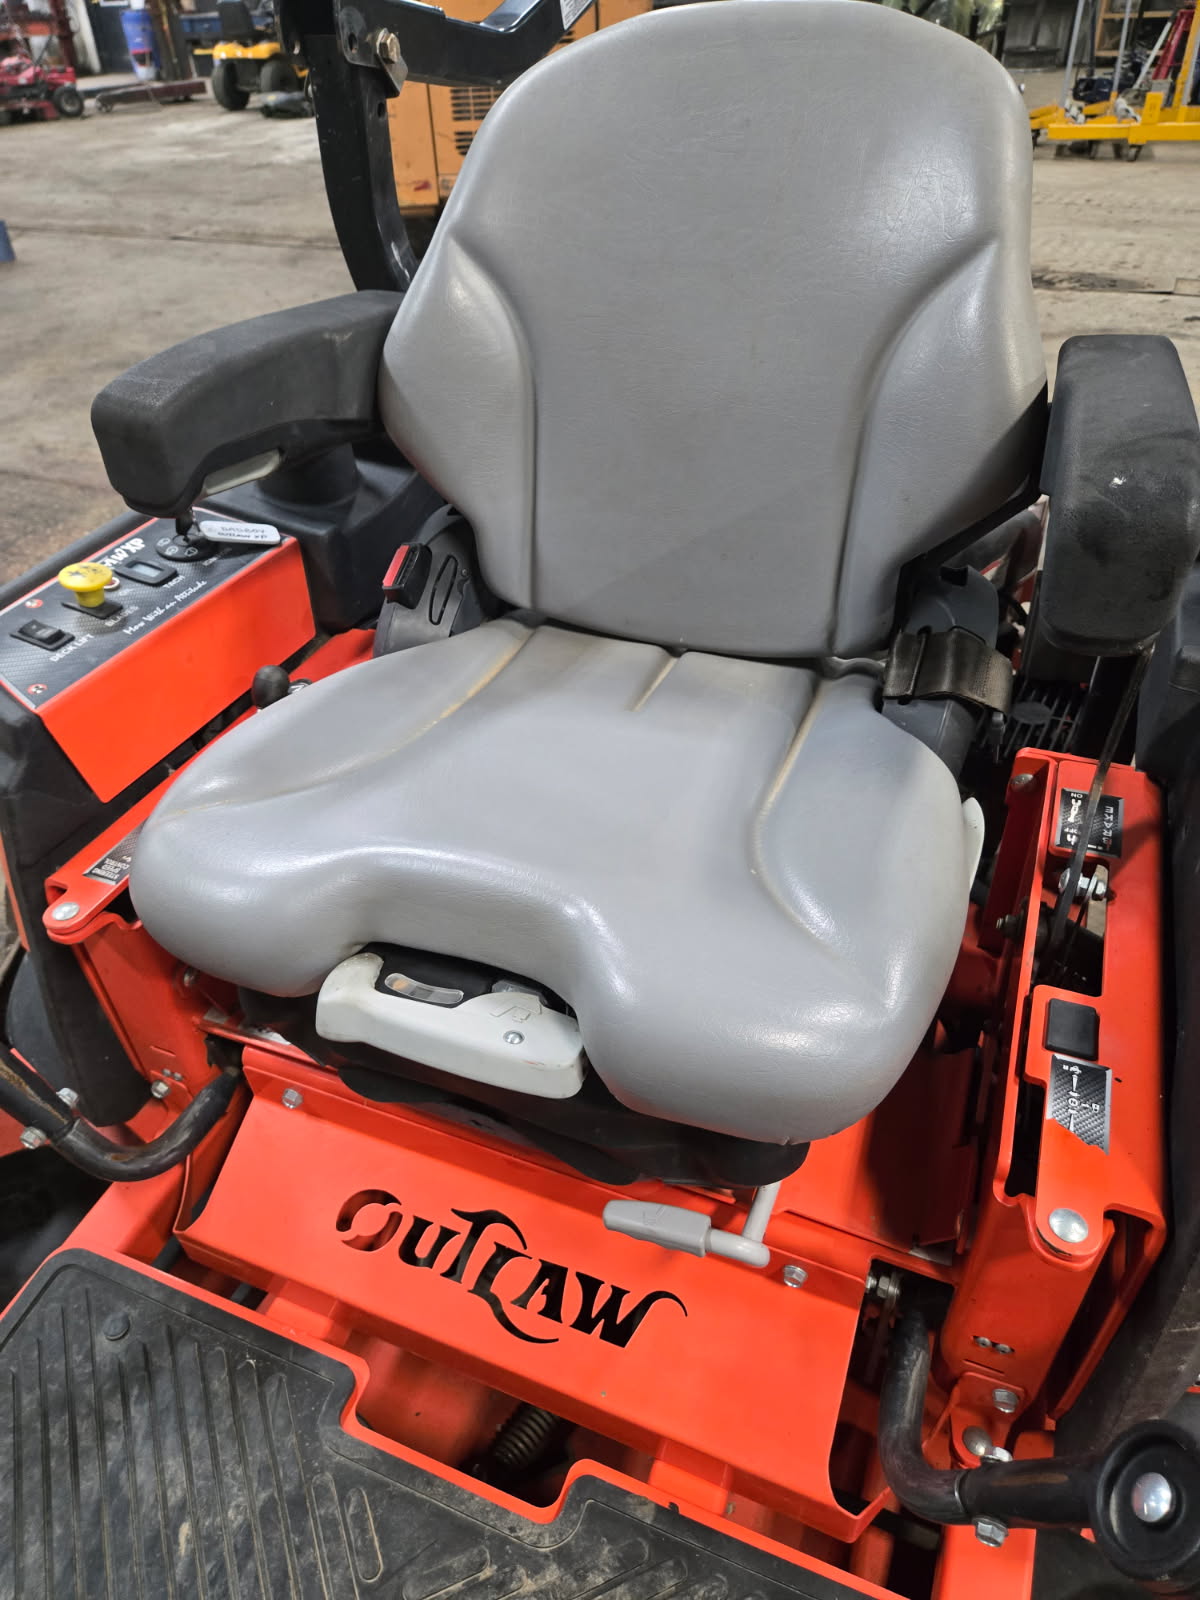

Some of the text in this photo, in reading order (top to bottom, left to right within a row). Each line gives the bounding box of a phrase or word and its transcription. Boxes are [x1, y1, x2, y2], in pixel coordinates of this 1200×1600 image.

[49, 634, 94, 661] DECK LIFT
[335, 1189, 688, 1348] OUTLAW
